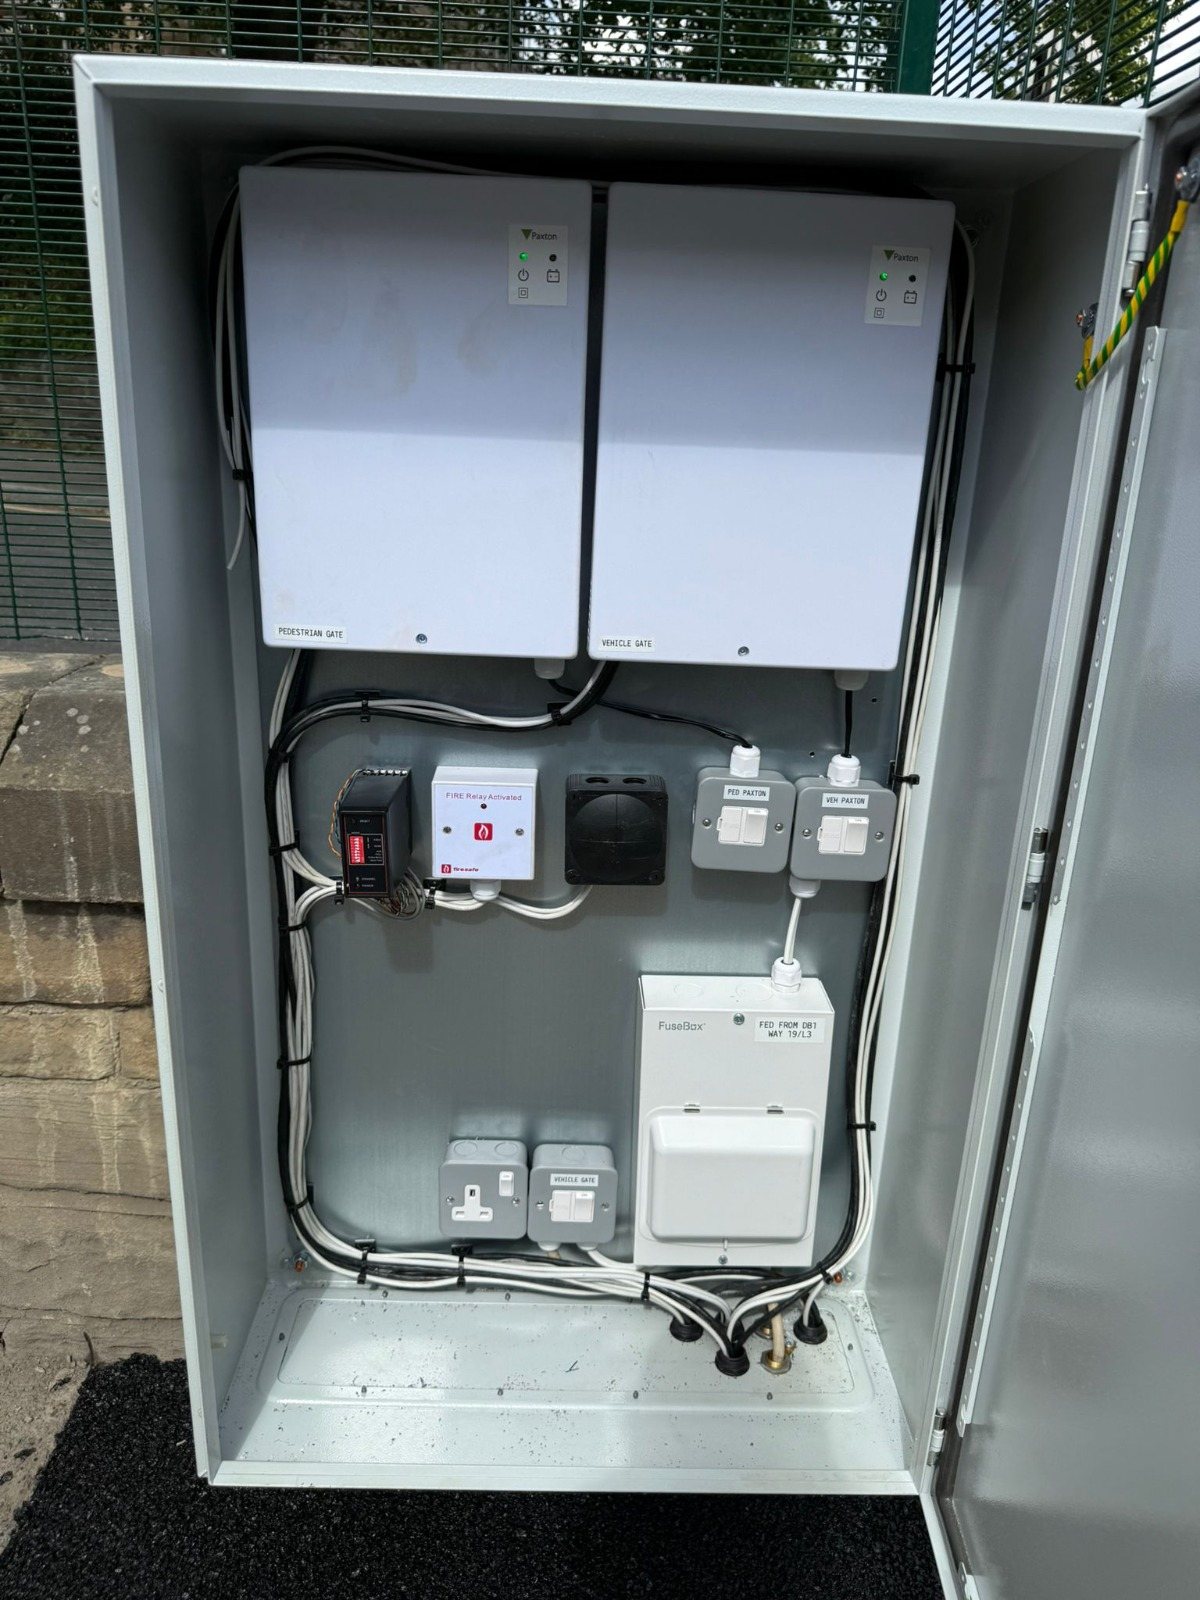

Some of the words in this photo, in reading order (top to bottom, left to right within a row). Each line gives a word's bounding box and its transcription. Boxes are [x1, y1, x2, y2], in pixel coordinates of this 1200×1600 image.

[531, 231, 558, 240] Paxton
[893, 252, 919, 262] Paxton
[278, 627, 322, 637] PEDESTRIAN
[325, 630, 344, 638] GATE
[602, 639, 632, 647] VEHICLE
[635, 639, 652, 648] GATE
[658, 1021, 703, 1030] FuseBox
[802, 1022, 816, 1030] DB1
